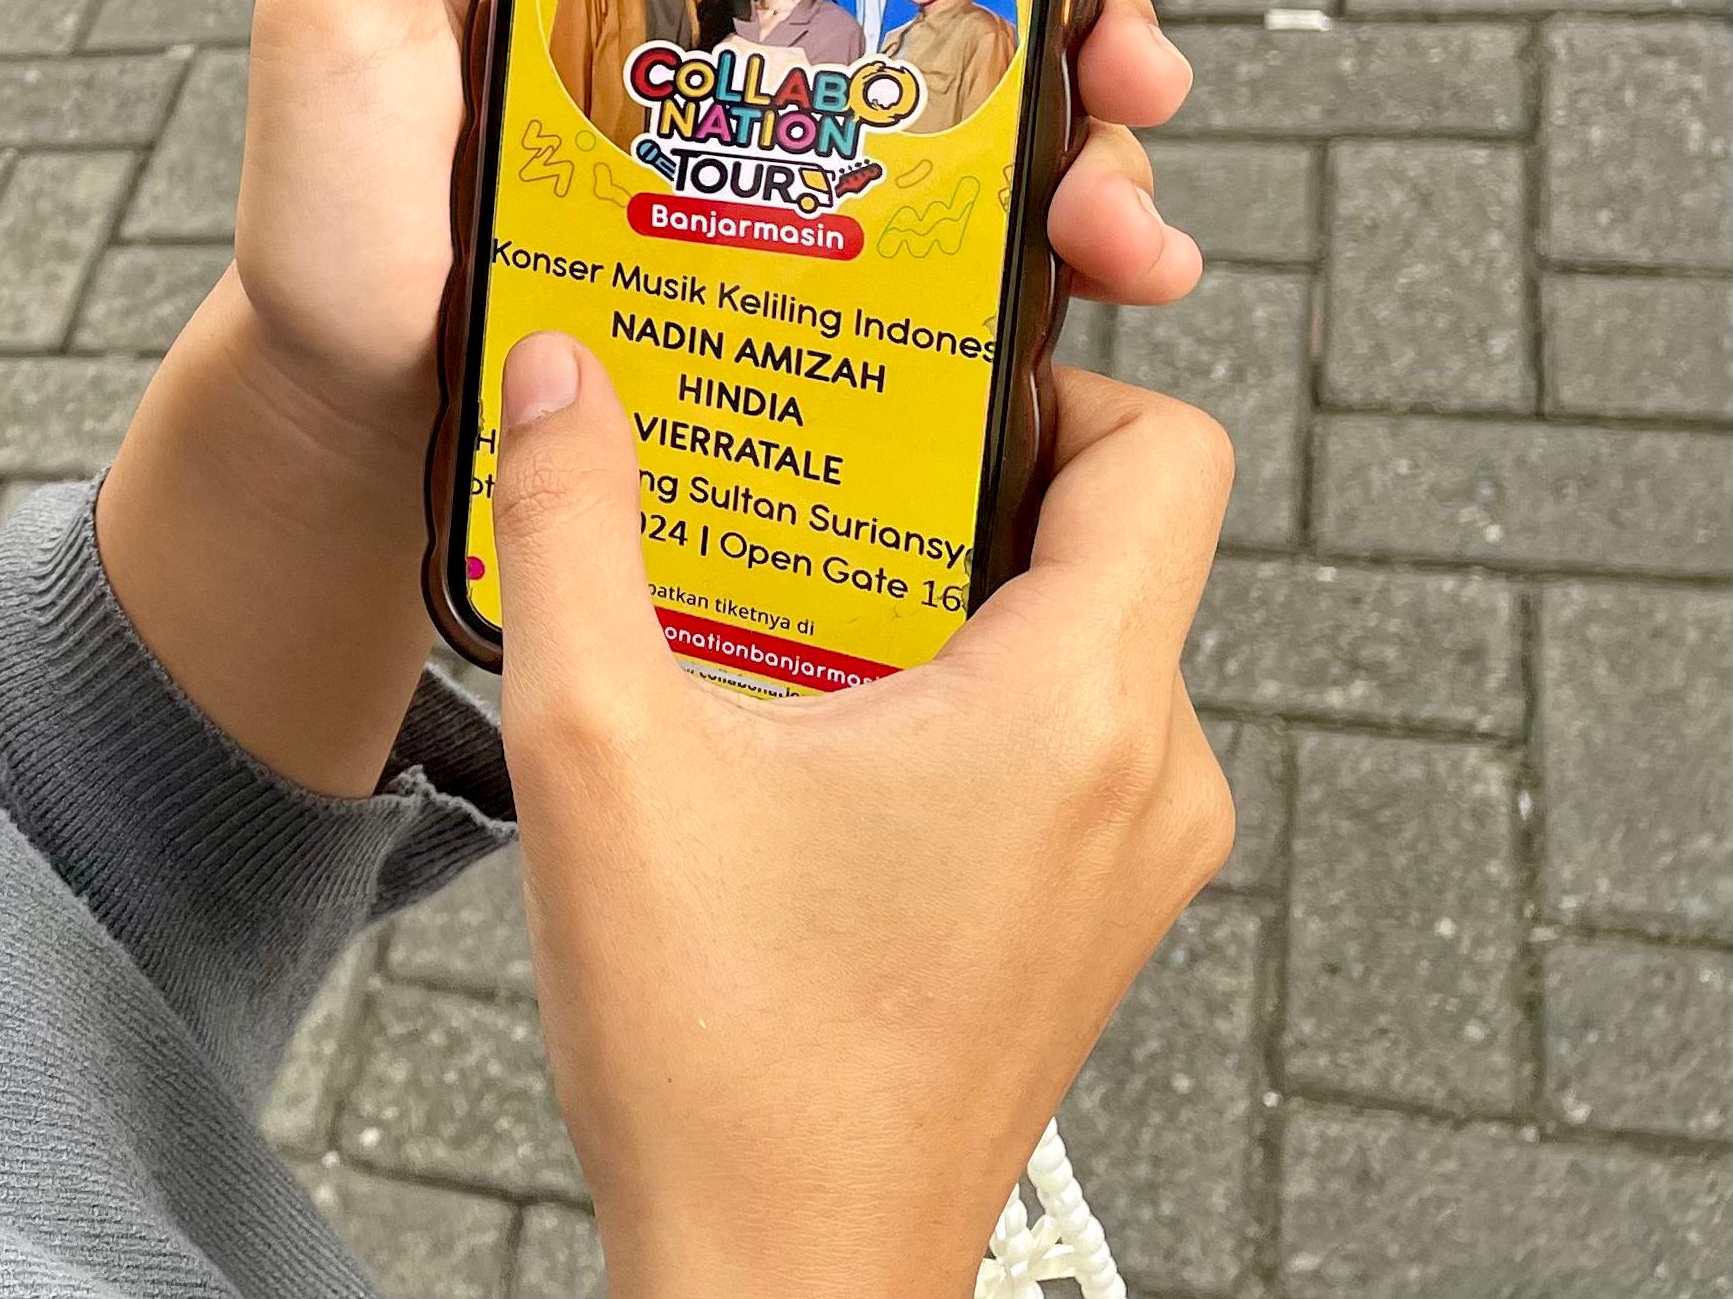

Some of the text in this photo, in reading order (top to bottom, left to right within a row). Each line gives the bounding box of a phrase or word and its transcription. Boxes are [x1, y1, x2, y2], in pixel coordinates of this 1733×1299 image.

[657, 99, 860, 160] NATION
[670, 148, 796, 203] TOUR
[650, 204, 845, 250] Banjarmasin
[492, 238, 605, 284] Konser
[611, 261, 707, 306] Musik
[717, 281, 843, 339] Keliling
[611, 310, 886, 393] NADIN AMIZAH
[678, 373, 804, 427] HINDIA
[633, 411, 844, 486] VIERRATALE
[689, 476, 797, 526] Sultan
[720, 531, 813, 577] Open
[822, 556, 909, 599] Gate
[715, 597, 791, 631] tiketnya
[797, 618, 815, 636] di
